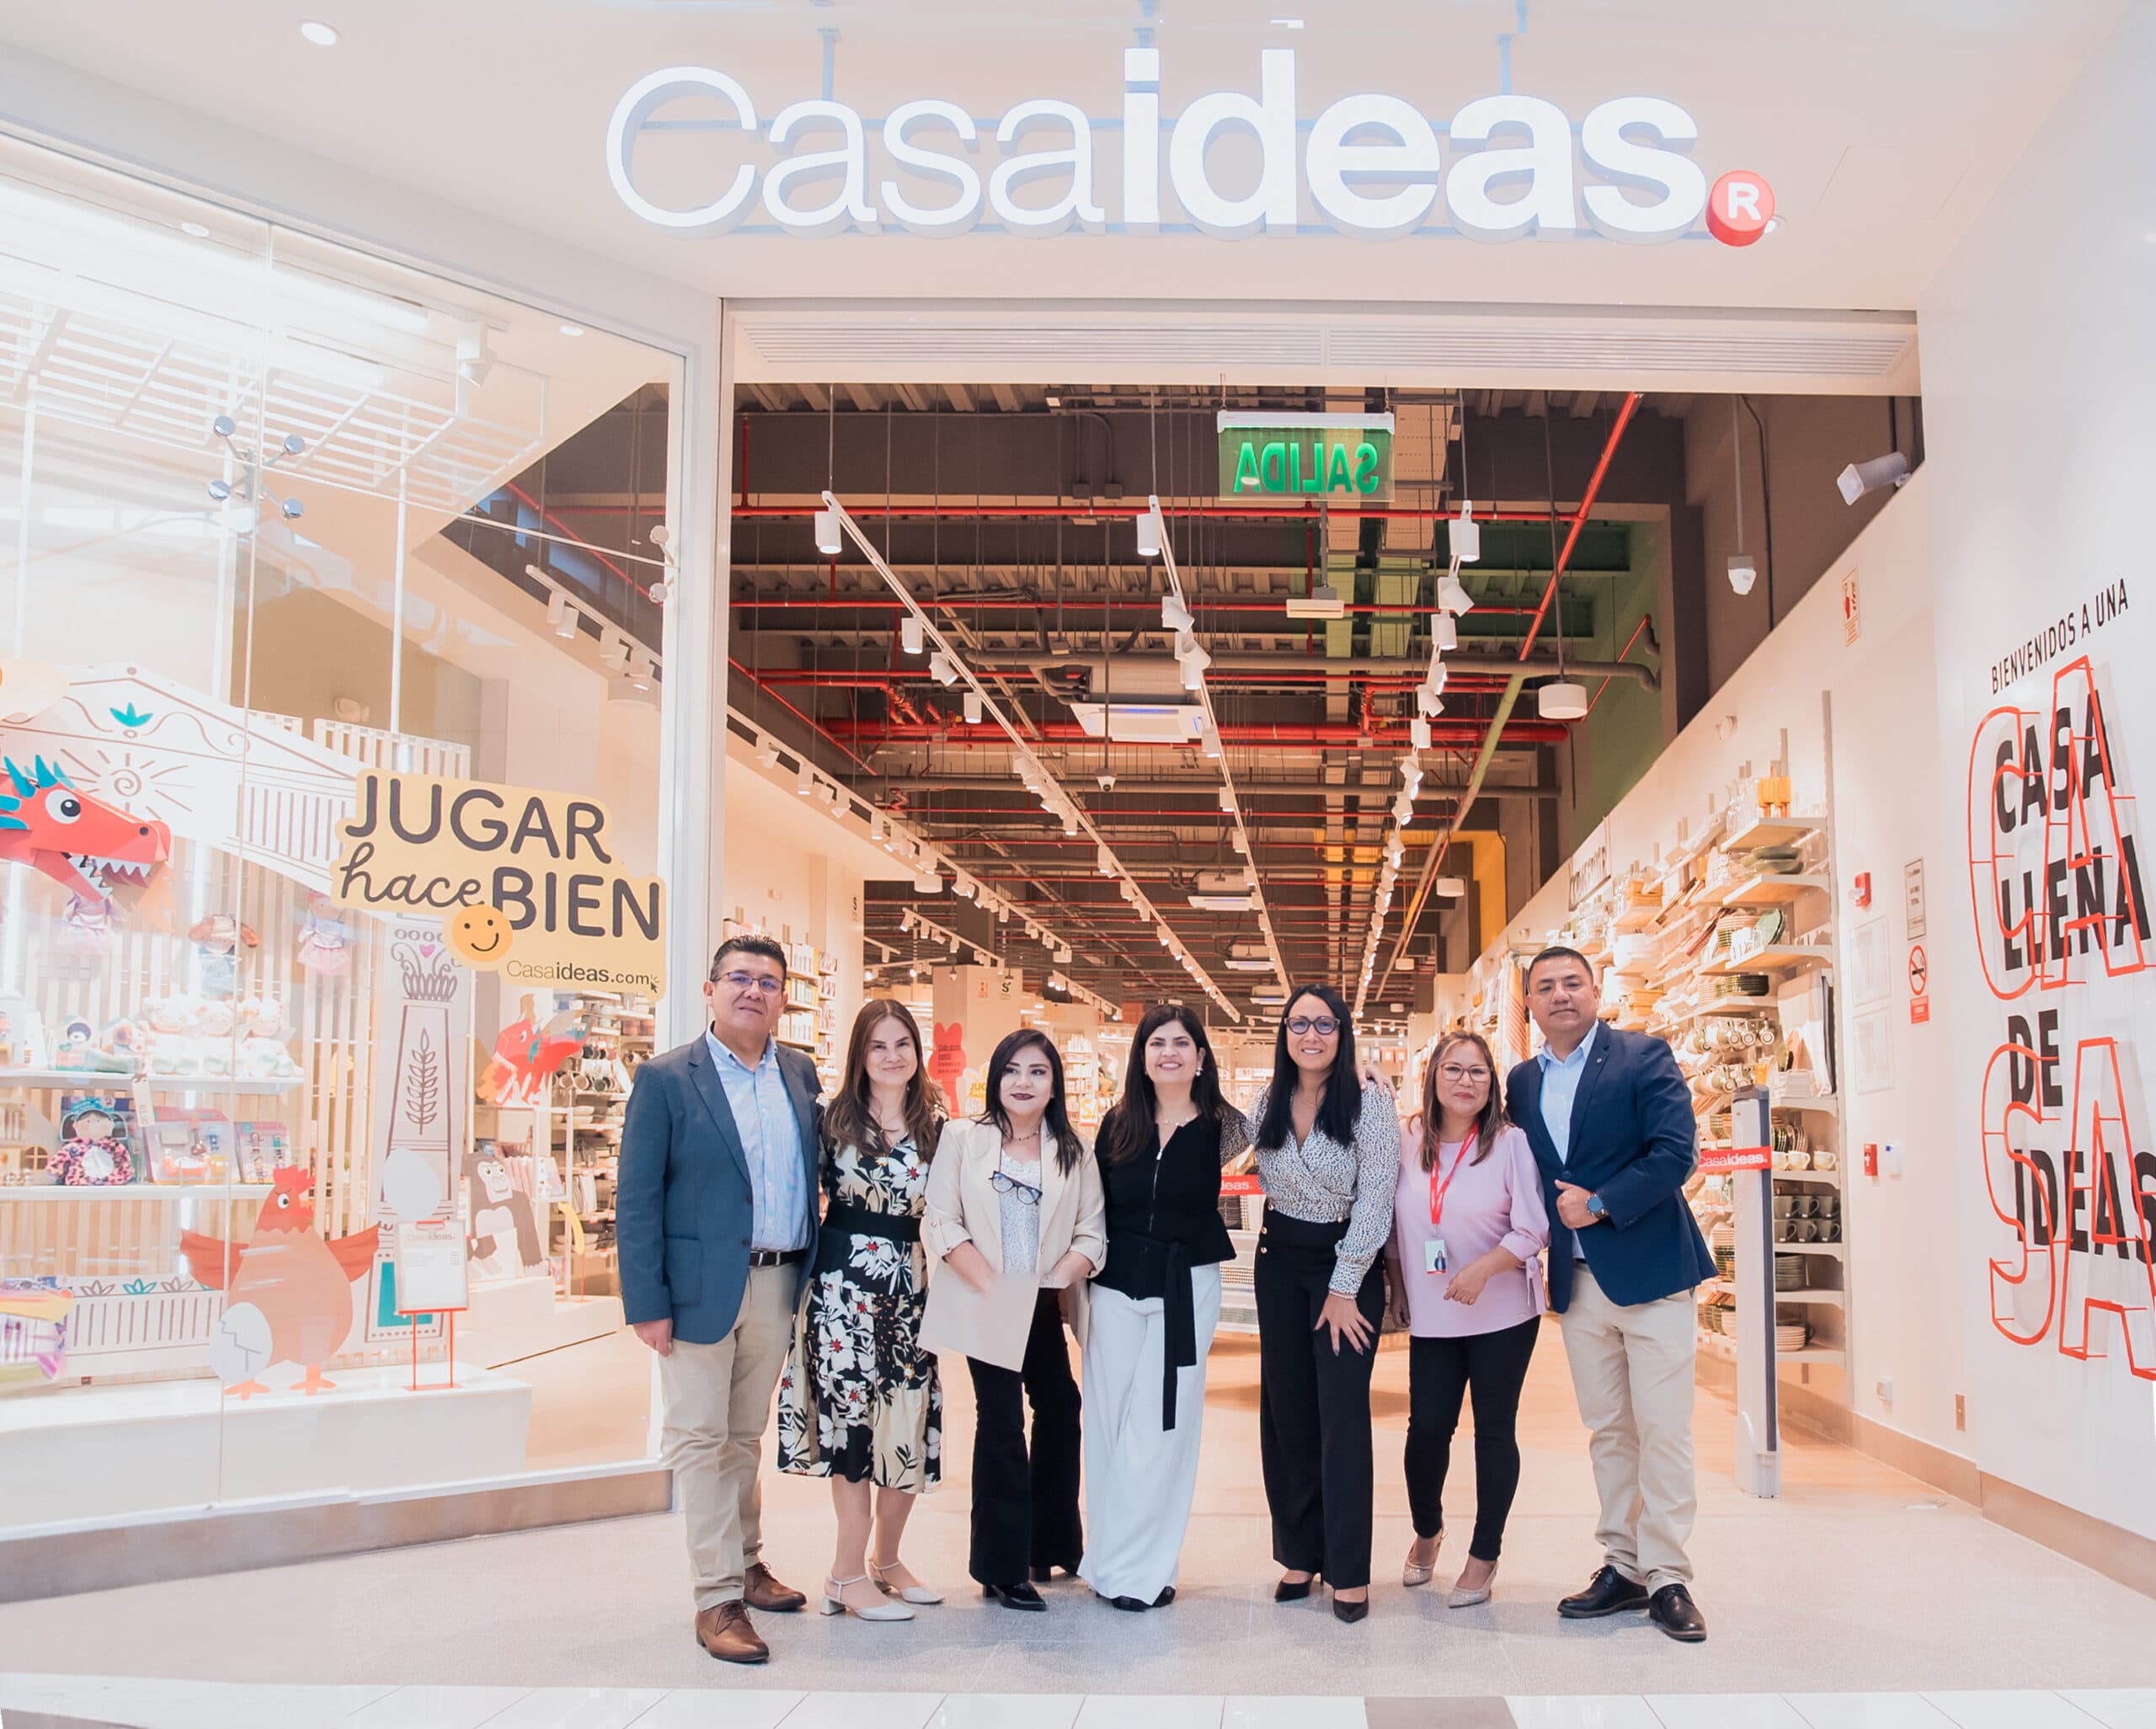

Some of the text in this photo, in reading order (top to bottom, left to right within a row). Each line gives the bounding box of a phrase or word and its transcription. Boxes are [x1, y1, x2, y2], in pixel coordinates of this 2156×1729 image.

[606, 46, 1706, 233] Casaideas
[1991, 578, 2128, 695] BIENVENIDOS A UNA
[1995, 689, 2116, 834] CASA
[344, 776, 612, 864] JUGAR
[339, 841, 659, 942] hace BIEN
[2001, 834, 2152, 971] LLENA
[507, 960, 649, 985] Casaideas.com
[2008, 1009, 2063, 1107] DE
[2014, 1149, 2156, 1265] IDEAS
